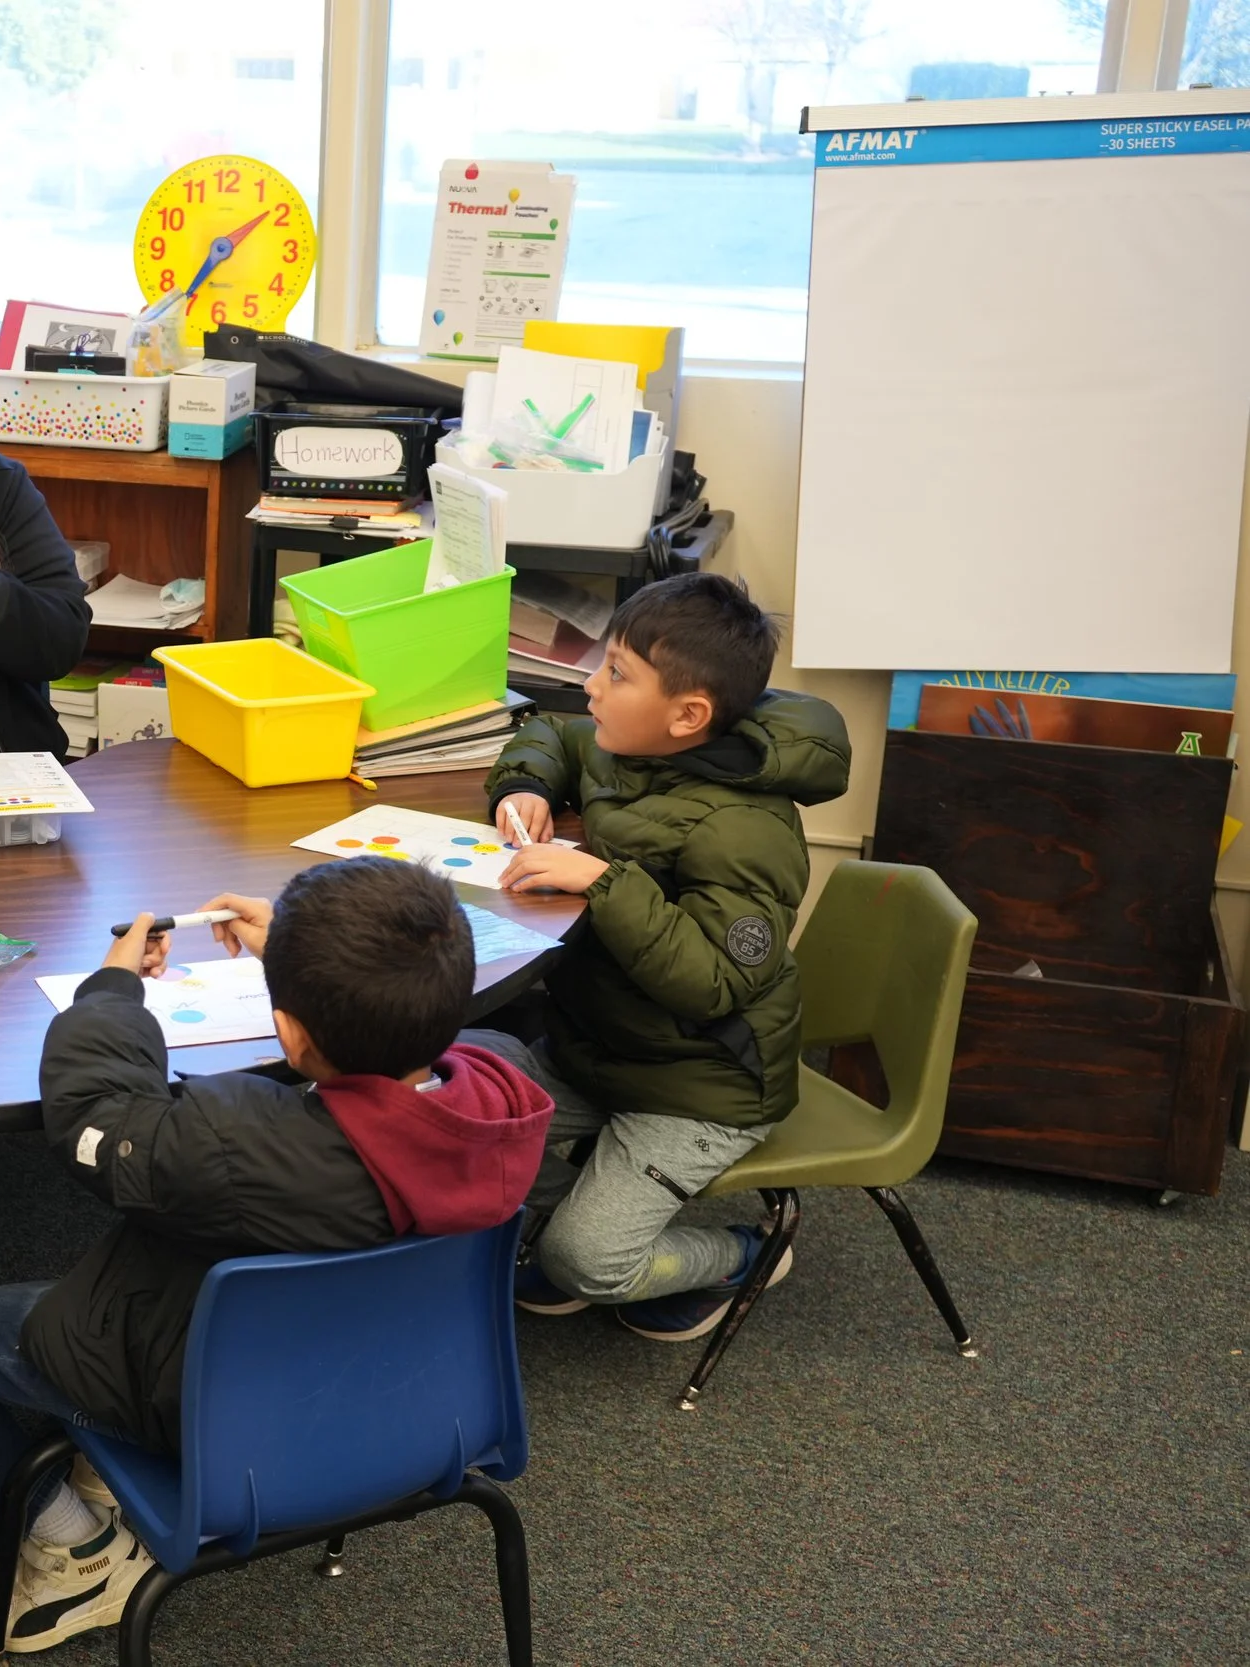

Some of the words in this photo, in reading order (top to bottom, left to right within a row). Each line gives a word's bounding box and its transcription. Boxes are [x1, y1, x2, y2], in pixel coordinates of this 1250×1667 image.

[1100, 123, 1143, 136] SUPER
[1145, 121, 1192, 134] STICKY
[1193, 119, 1233, 132] EASEL
[826, 129, 919, 152] AFMAT
[1126, 136, 1176, 149] SHEETS
[825, 152, 896, 162] www.afmat.com
[183, 179, 206, 203] 11
[213, 169, 241, 193] 12
[254, 179, 266, 203] 1
[157, 207, 185, 232] 10
[273, 203, 291, 227] 2
[449, 201, 508, 216] Thermal
[150, 236, 166, 260] 9
[282, 239, 299, 263] 3
[159, 269, 175, 293] 8
[268, 273, 285, 297] 4
[185, 293, 199, 317] 7
[211, 300, 227, 325] 6
[242, 294, 260, 318] 5
[280, 434, 396, 465] Homework
[1175, 732, 1203, 756] A
[77, 1556, 111, 1576] PUMA
